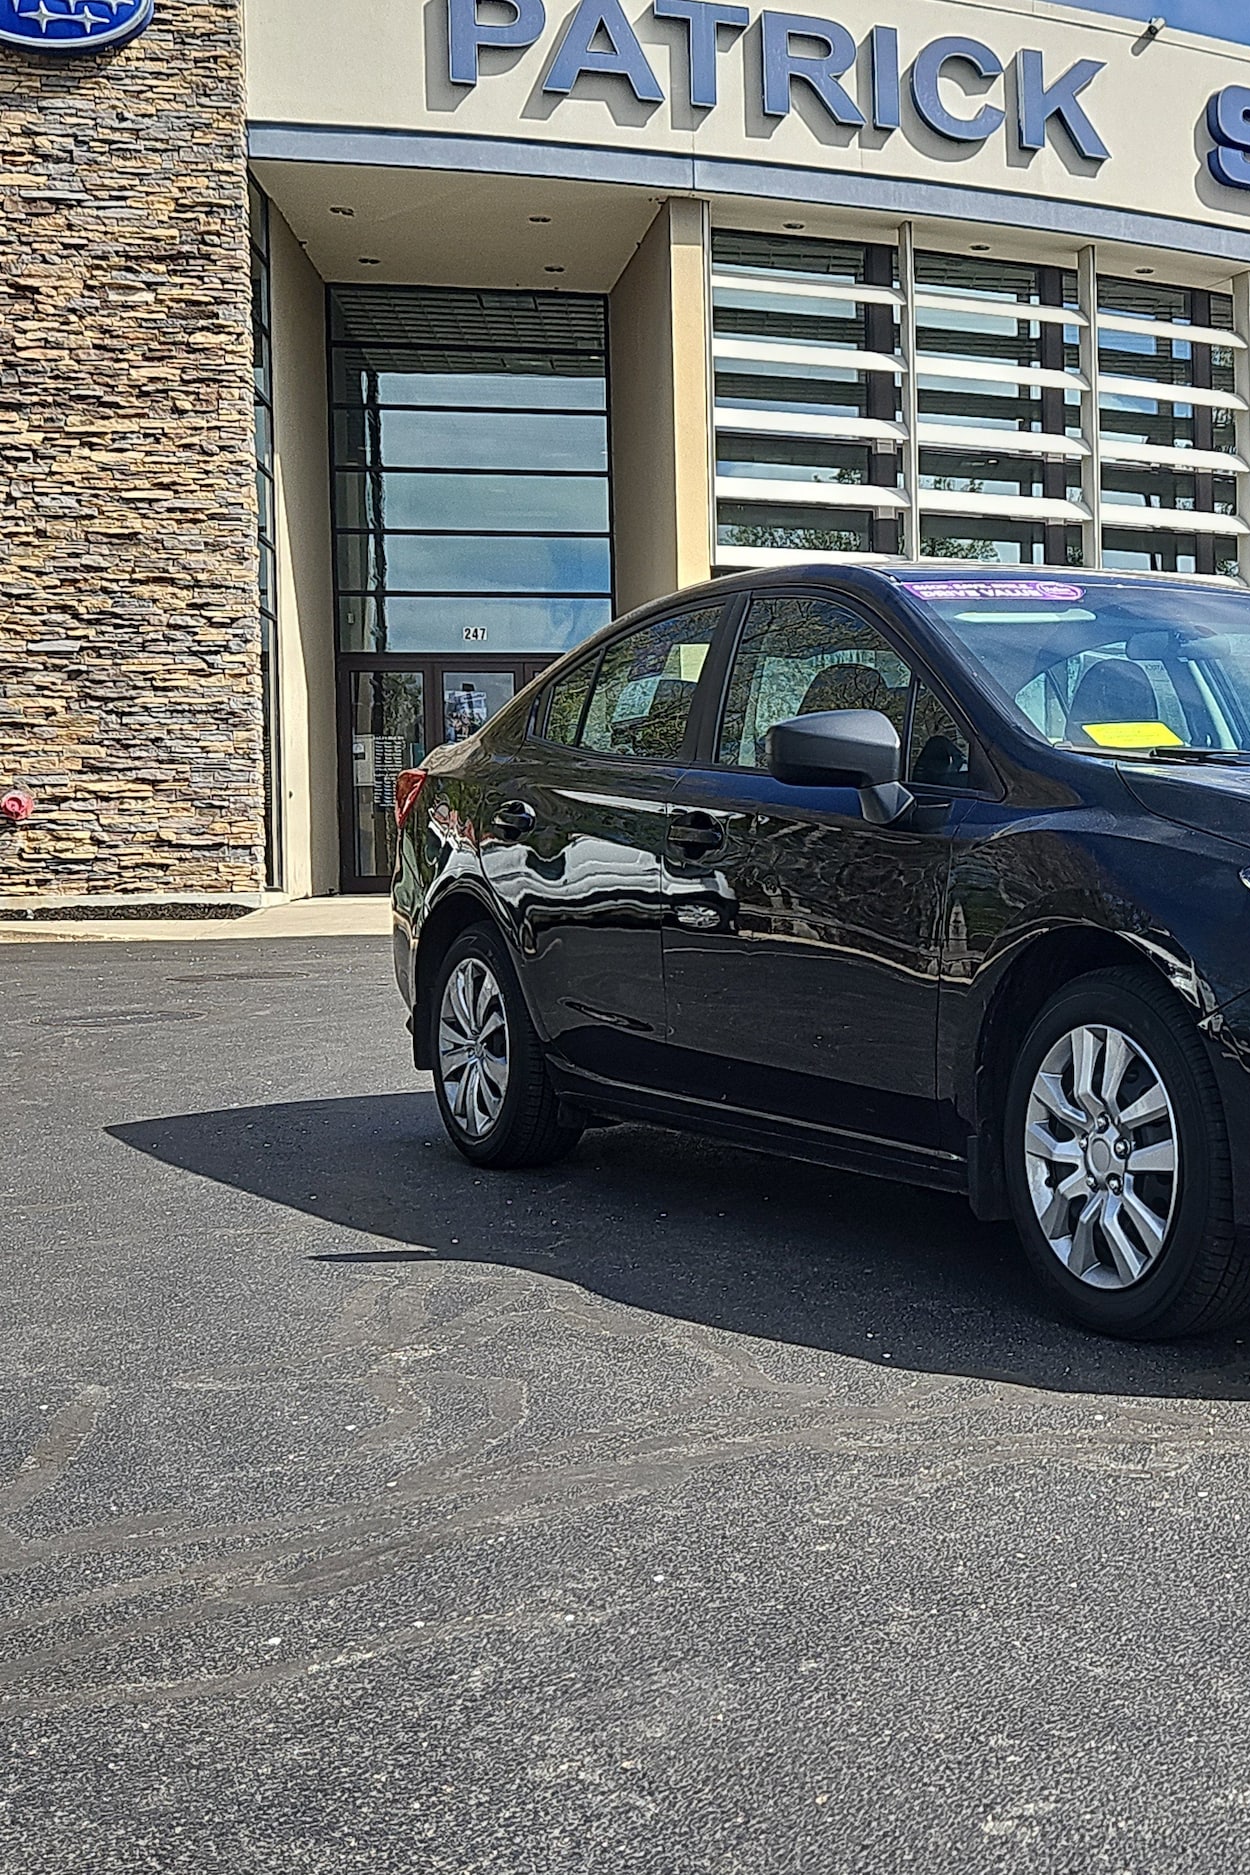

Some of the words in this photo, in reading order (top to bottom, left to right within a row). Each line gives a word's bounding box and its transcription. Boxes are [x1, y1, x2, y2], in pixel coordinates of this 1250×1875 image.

[447, 0, 1112, 161] PATRICK
[919, 590, 980, 598] DRIVE
[979, 589, 1044, 598] VALUE
[464, 627, 487, 641] 247
